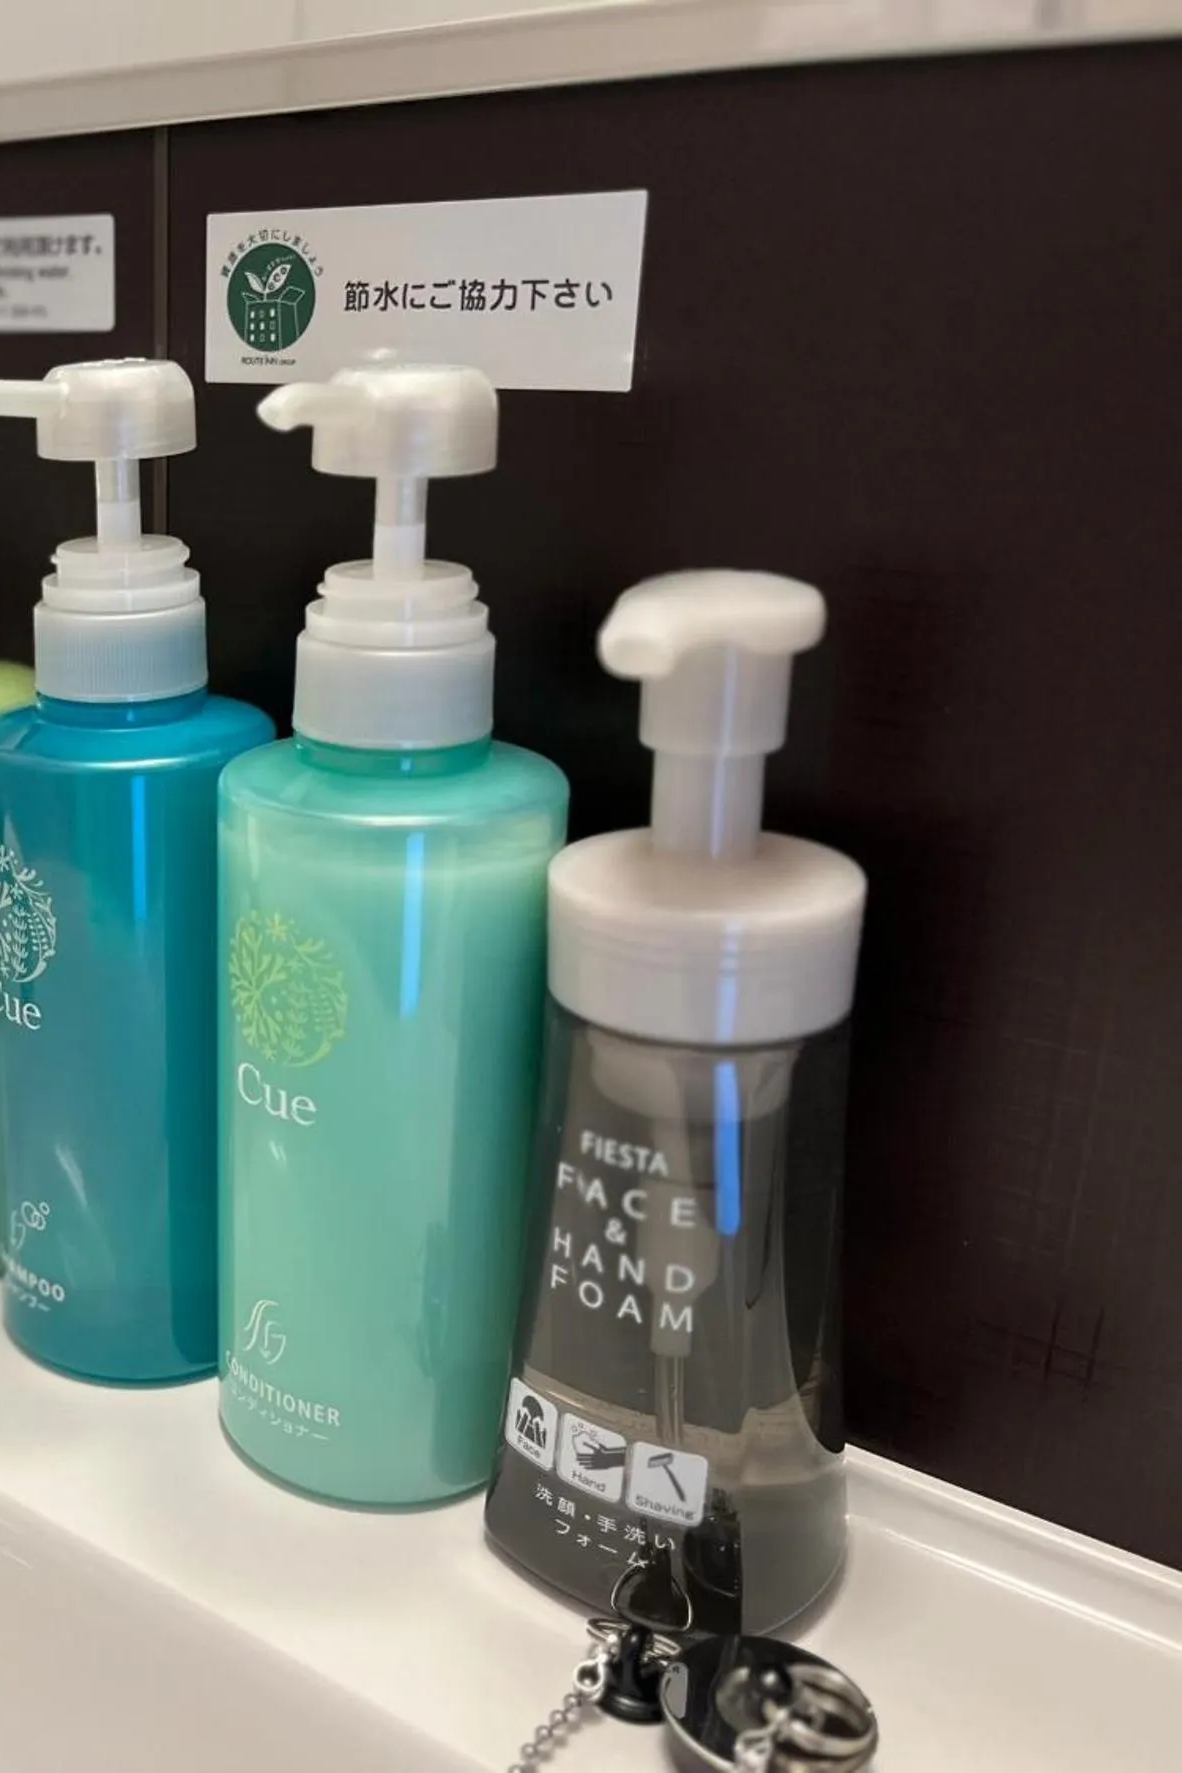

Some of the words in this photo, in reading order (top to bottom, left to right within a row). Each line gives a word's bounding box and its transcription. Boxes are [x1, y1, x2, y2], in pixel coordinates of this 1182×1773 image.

[343, 278, 613, 313] 節水にご協力下さい
[237, 1062, 317, 1127] Cue
[580, 1130, 668, 1177] FIESTA
[557, 1161, 697, 1228] FACE
[604, 1219, 627, 1246] &
[553, 1226, 695, 1294] HAND
[550, 1264, 693, 1333] FOAM
[226, 1350, 340, 1427] CONDITIONER
[518, 1434, 541, 1459] Face
[571, 1470, 606, 1493] Hand
[635, 1494, 695, 1520] Shaving
[534, 1482, 676, 1550] 洗顔・手洗い
[555, 1518, 648, 1569] フォーム
